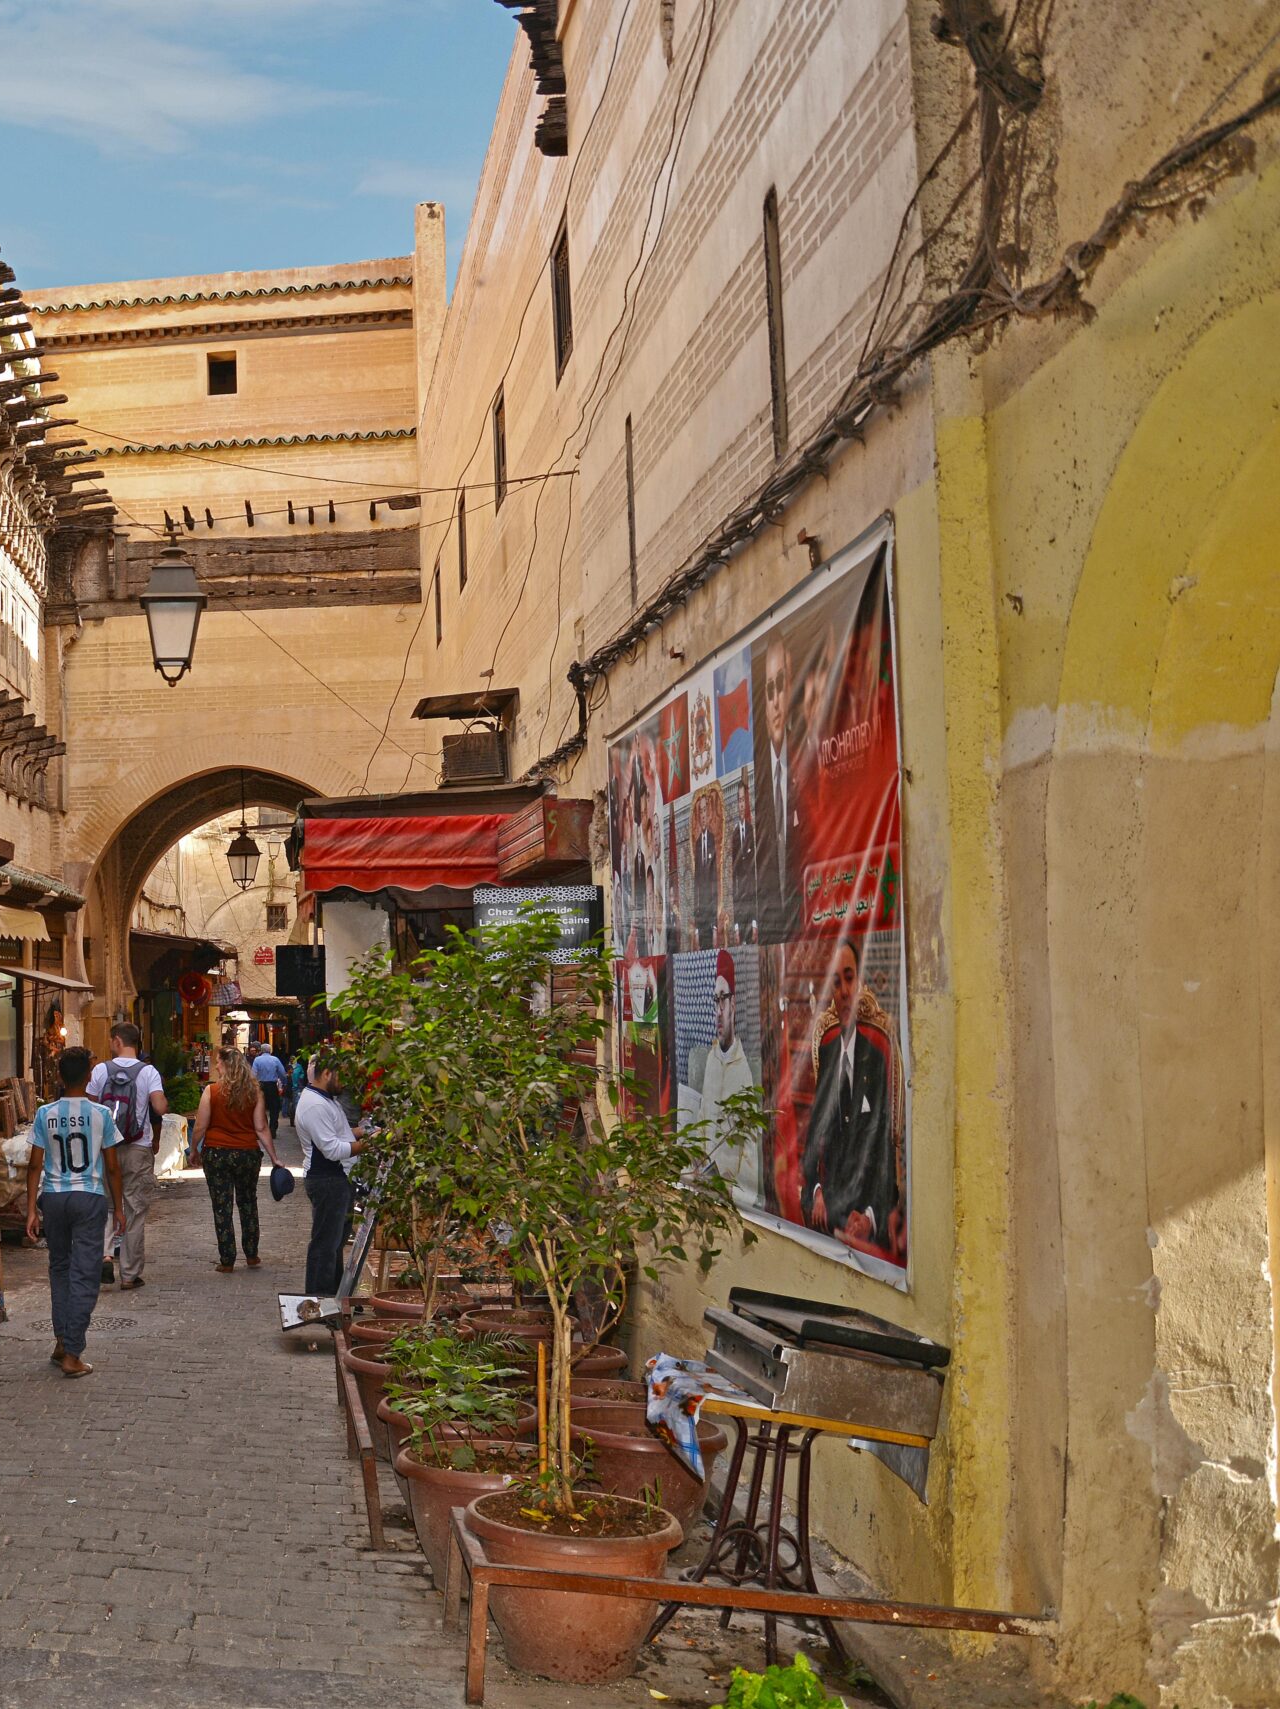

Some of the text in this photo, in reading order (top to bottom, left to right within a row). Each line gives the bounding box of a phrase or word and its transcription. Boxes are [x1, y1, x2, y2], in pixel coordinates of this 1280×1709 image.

[821, 721, 872, 766] MOHAMED
[487, 908, 514, 916] Chez
[479, 919, 492, 927] La
[48, 1116, 91, 1129] MESSI
[52, 1132, 90, 1174] 10
